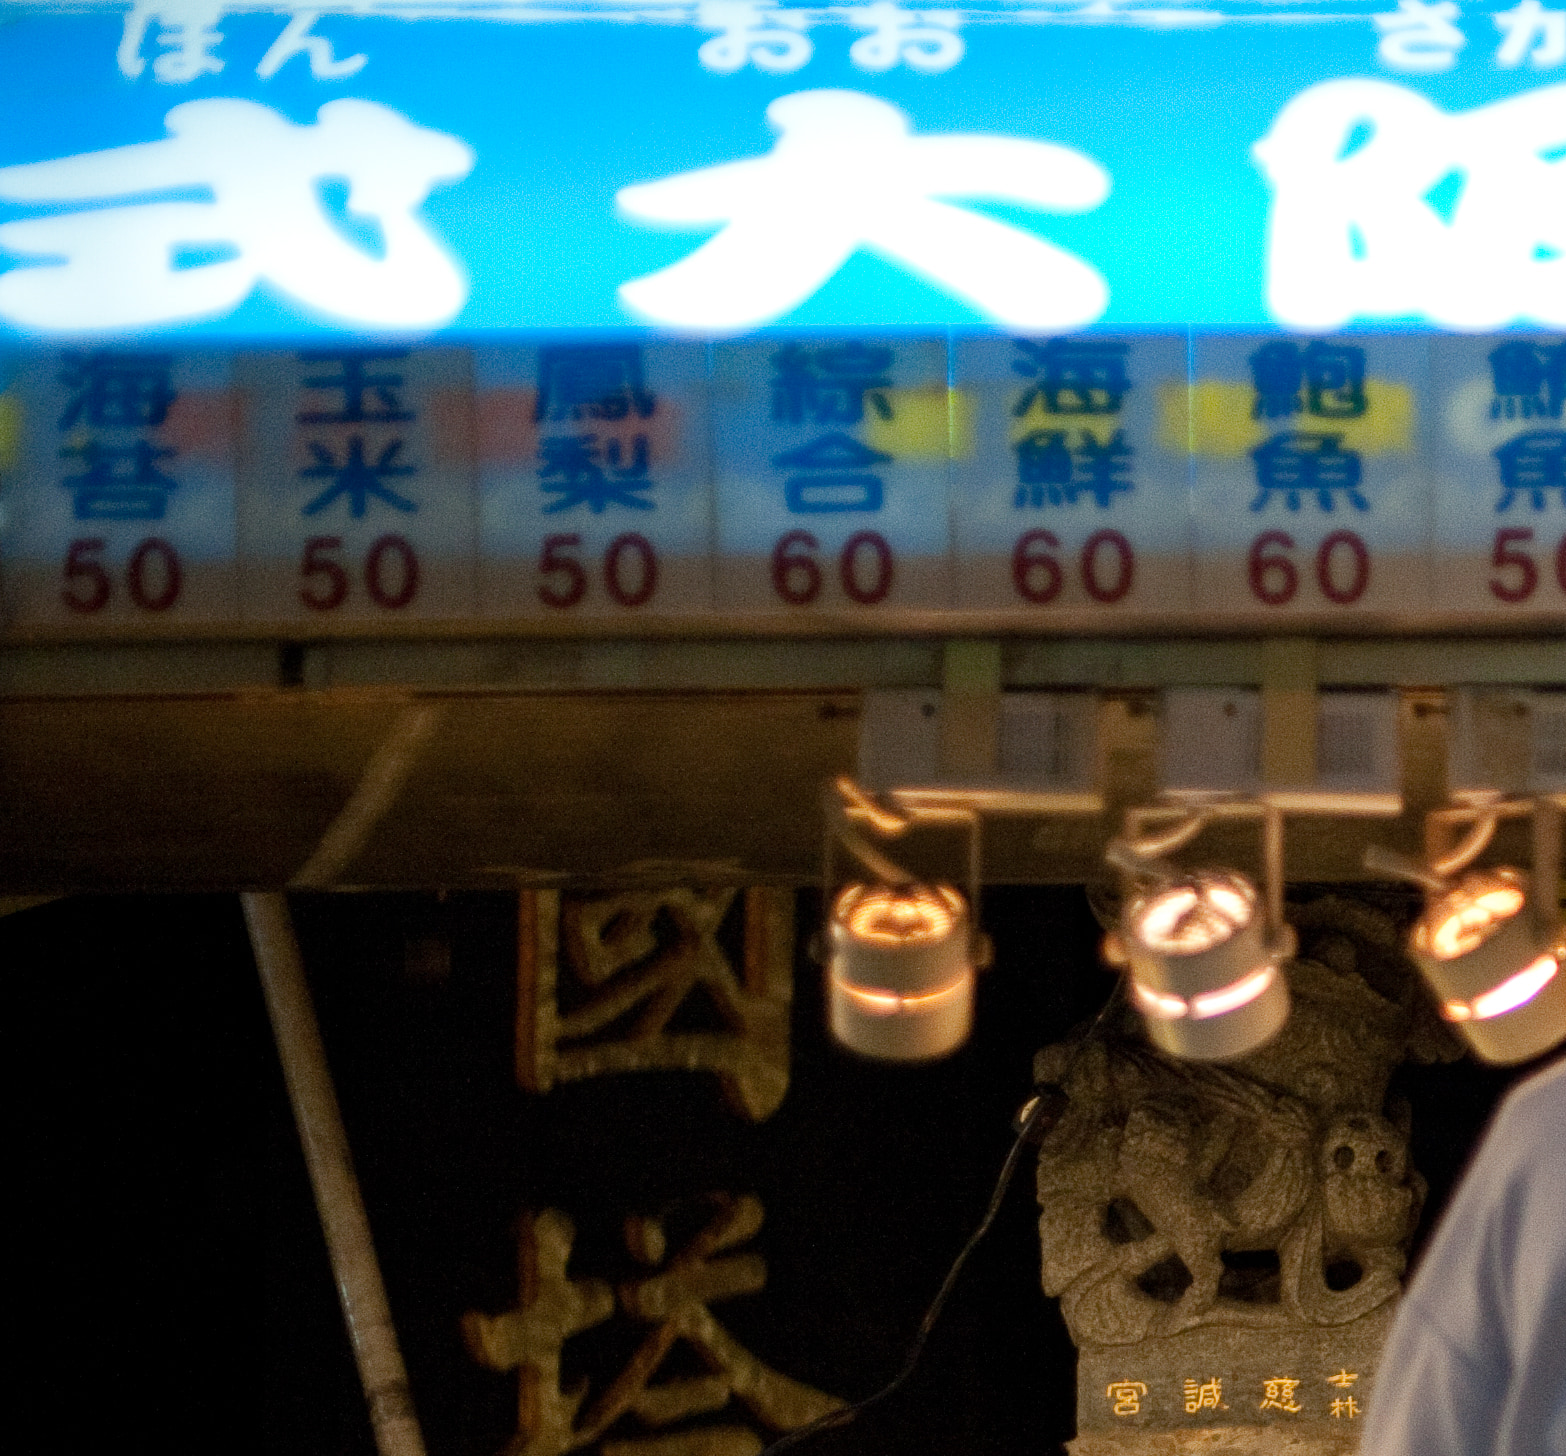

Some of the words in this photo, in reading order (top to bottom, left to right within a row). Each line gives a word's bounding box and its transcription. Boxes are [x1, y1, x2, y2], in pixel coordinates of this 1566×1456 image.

[296, 350, 418, 520] 玉米
[62, 536, 183, 613] 50
[300, 533, 420, 611] 50
[537, 532, 659, 609] 50
[770, 530, 894, 605] 60
[1011, 529, 1134, 604] 60
[1247, 529, 1370, 604] 60
